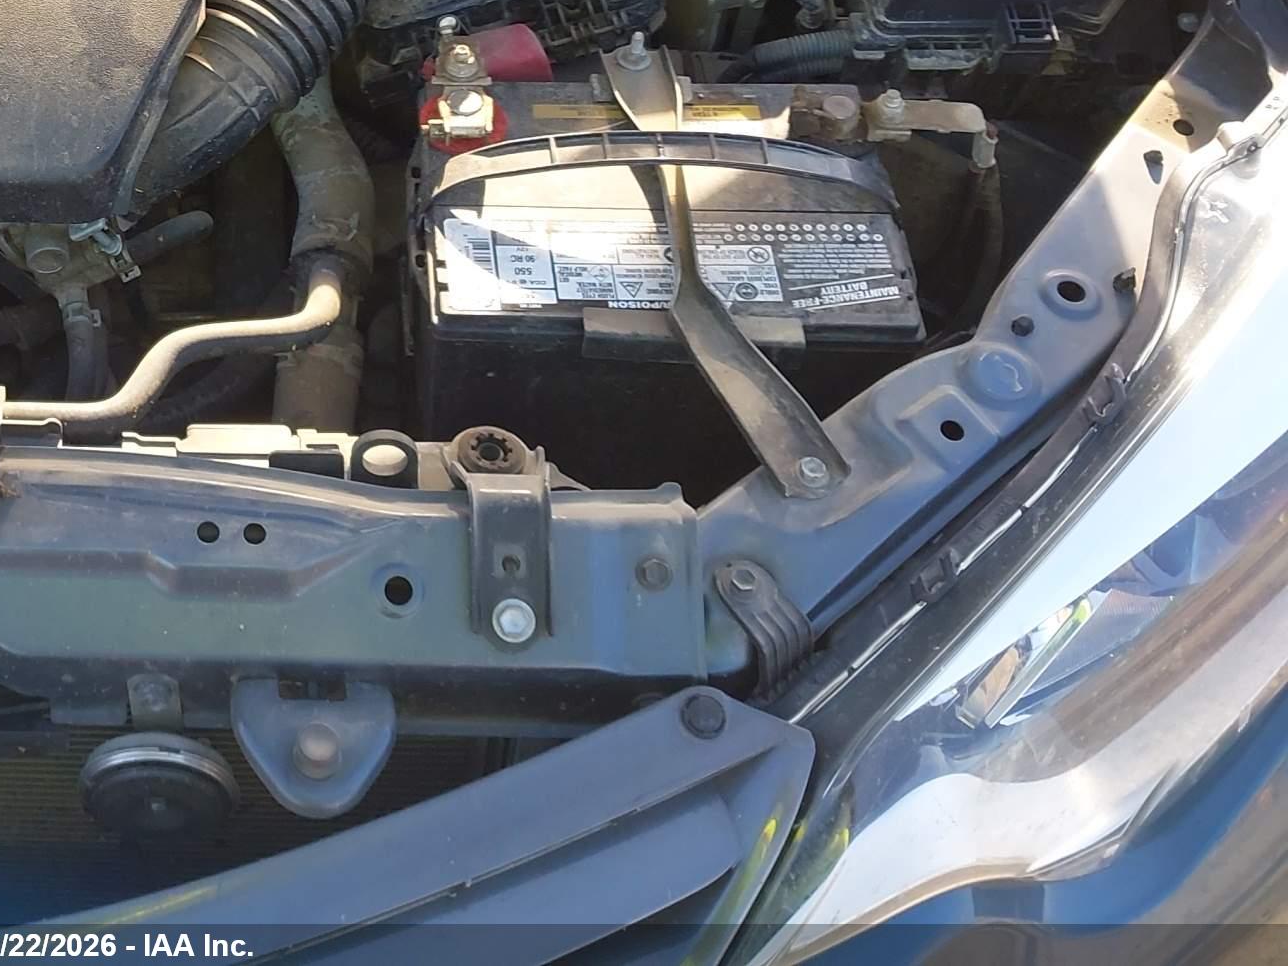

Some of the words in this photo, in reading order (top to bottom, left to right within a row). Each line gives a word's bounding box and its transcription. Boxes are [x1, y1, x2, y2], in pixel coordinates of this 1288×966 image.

[509, 254, 523, 263] RC
[524, 254, 535, 263] 90
[513, 266, 532, 275] 550
[819, 280, 869, 295] BATTERY
[791, 285, 900, 309] MAINTENANCE-FREE
